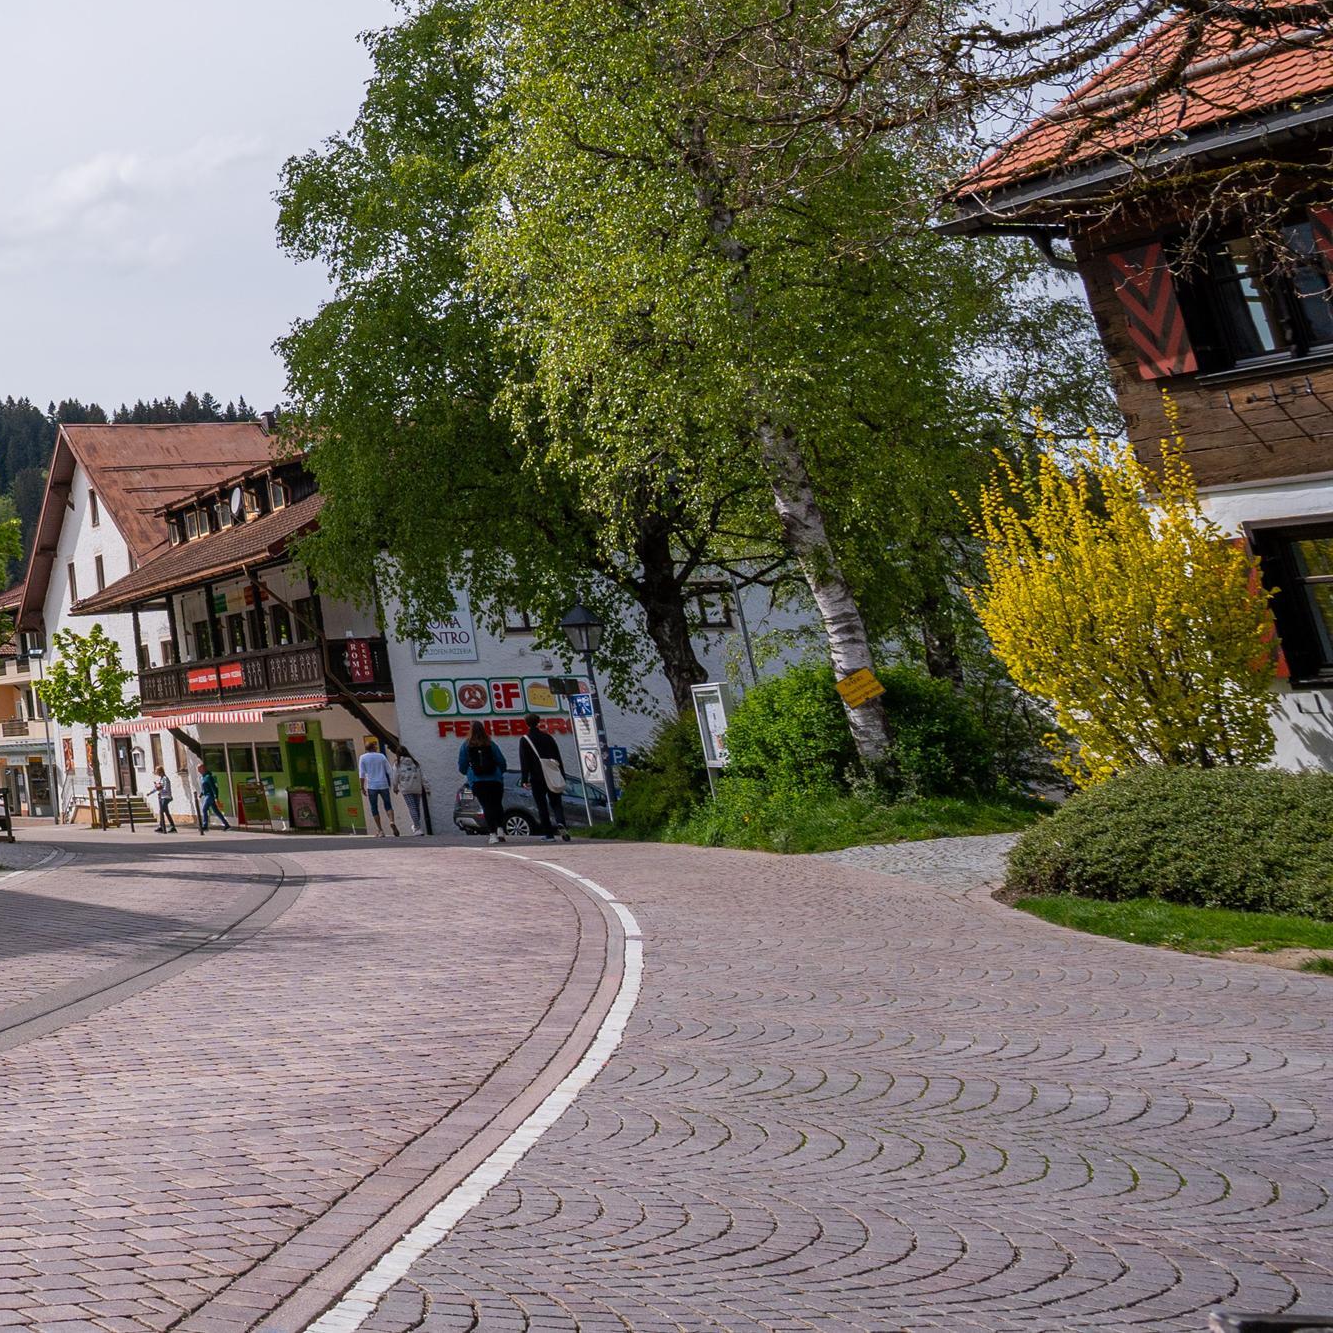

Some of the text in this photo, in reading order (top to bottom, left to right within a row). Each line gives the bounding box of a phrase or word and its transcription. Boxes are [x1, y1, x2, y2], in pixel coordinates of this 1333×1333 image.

[432, 631, 470, 644] NTRO
[350, 643, 361, 677] ROMA
[360, 643, 370, 676] CENTRO
[613, 749, 624, 764] P
